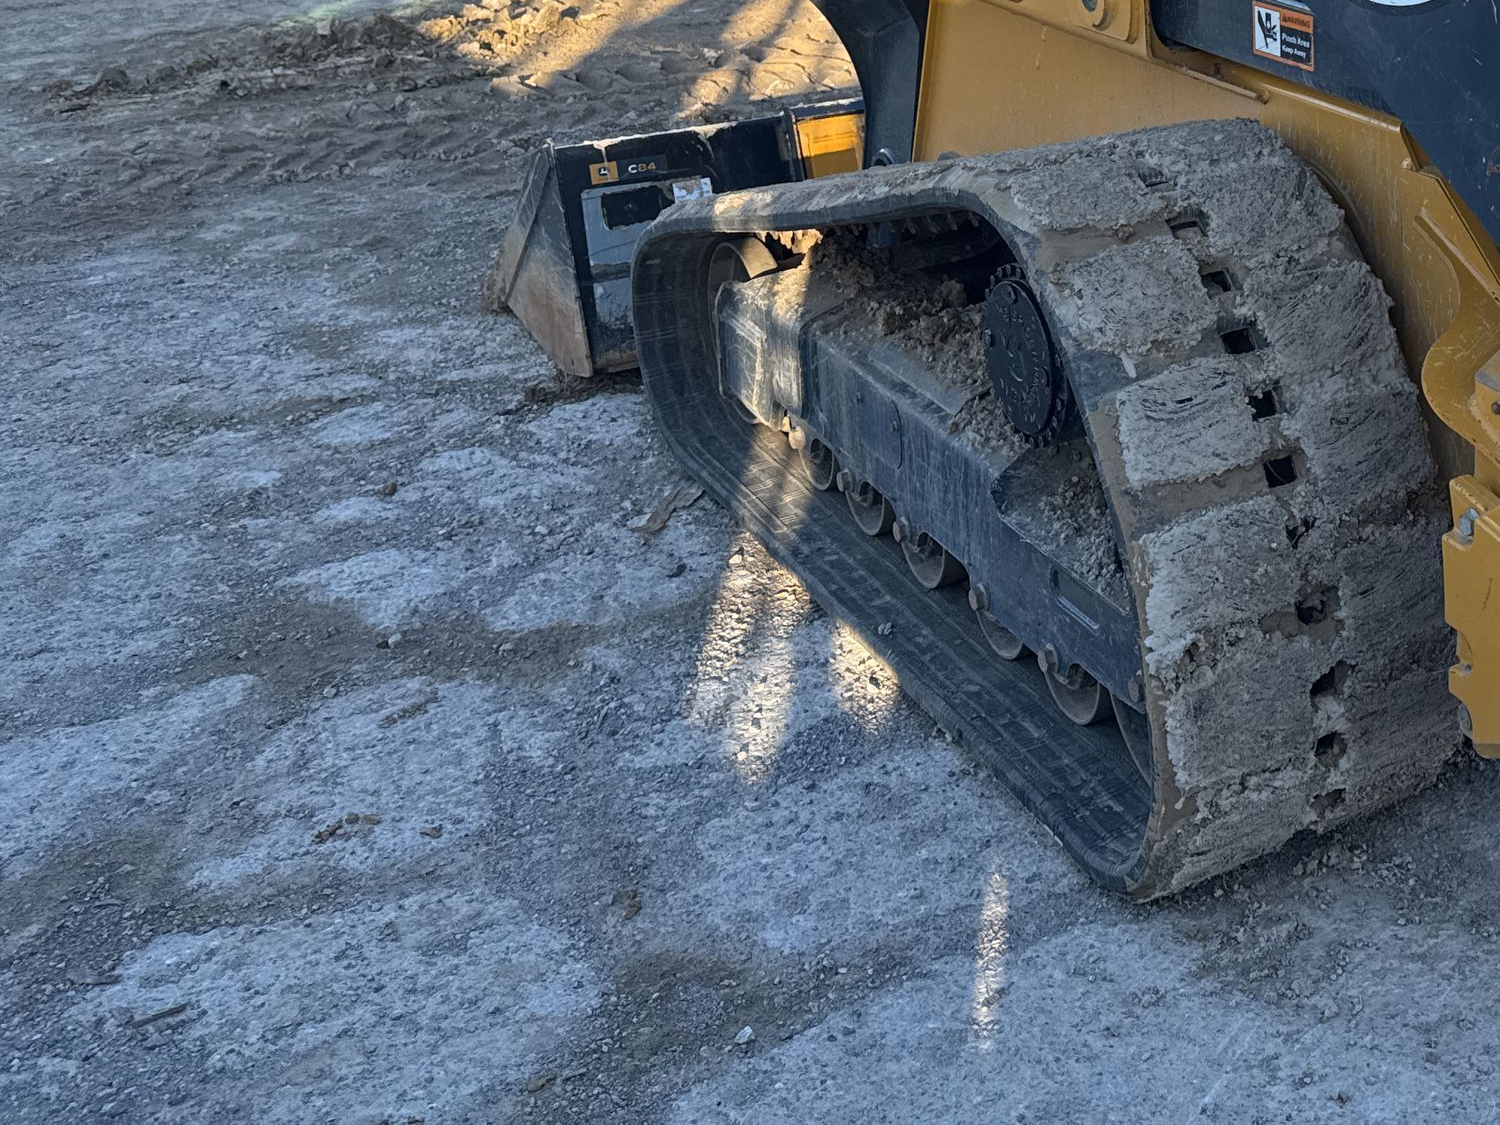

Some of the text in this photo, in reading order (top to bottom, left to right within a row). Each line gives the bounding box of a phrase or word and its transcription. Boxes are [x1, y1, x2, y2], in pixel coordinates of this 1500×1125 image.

[1282, 33, 1310, 48] Pinch Area
[1282, 45, 1307, 59] Keep Away
[628, 162, 657, 173] C84
